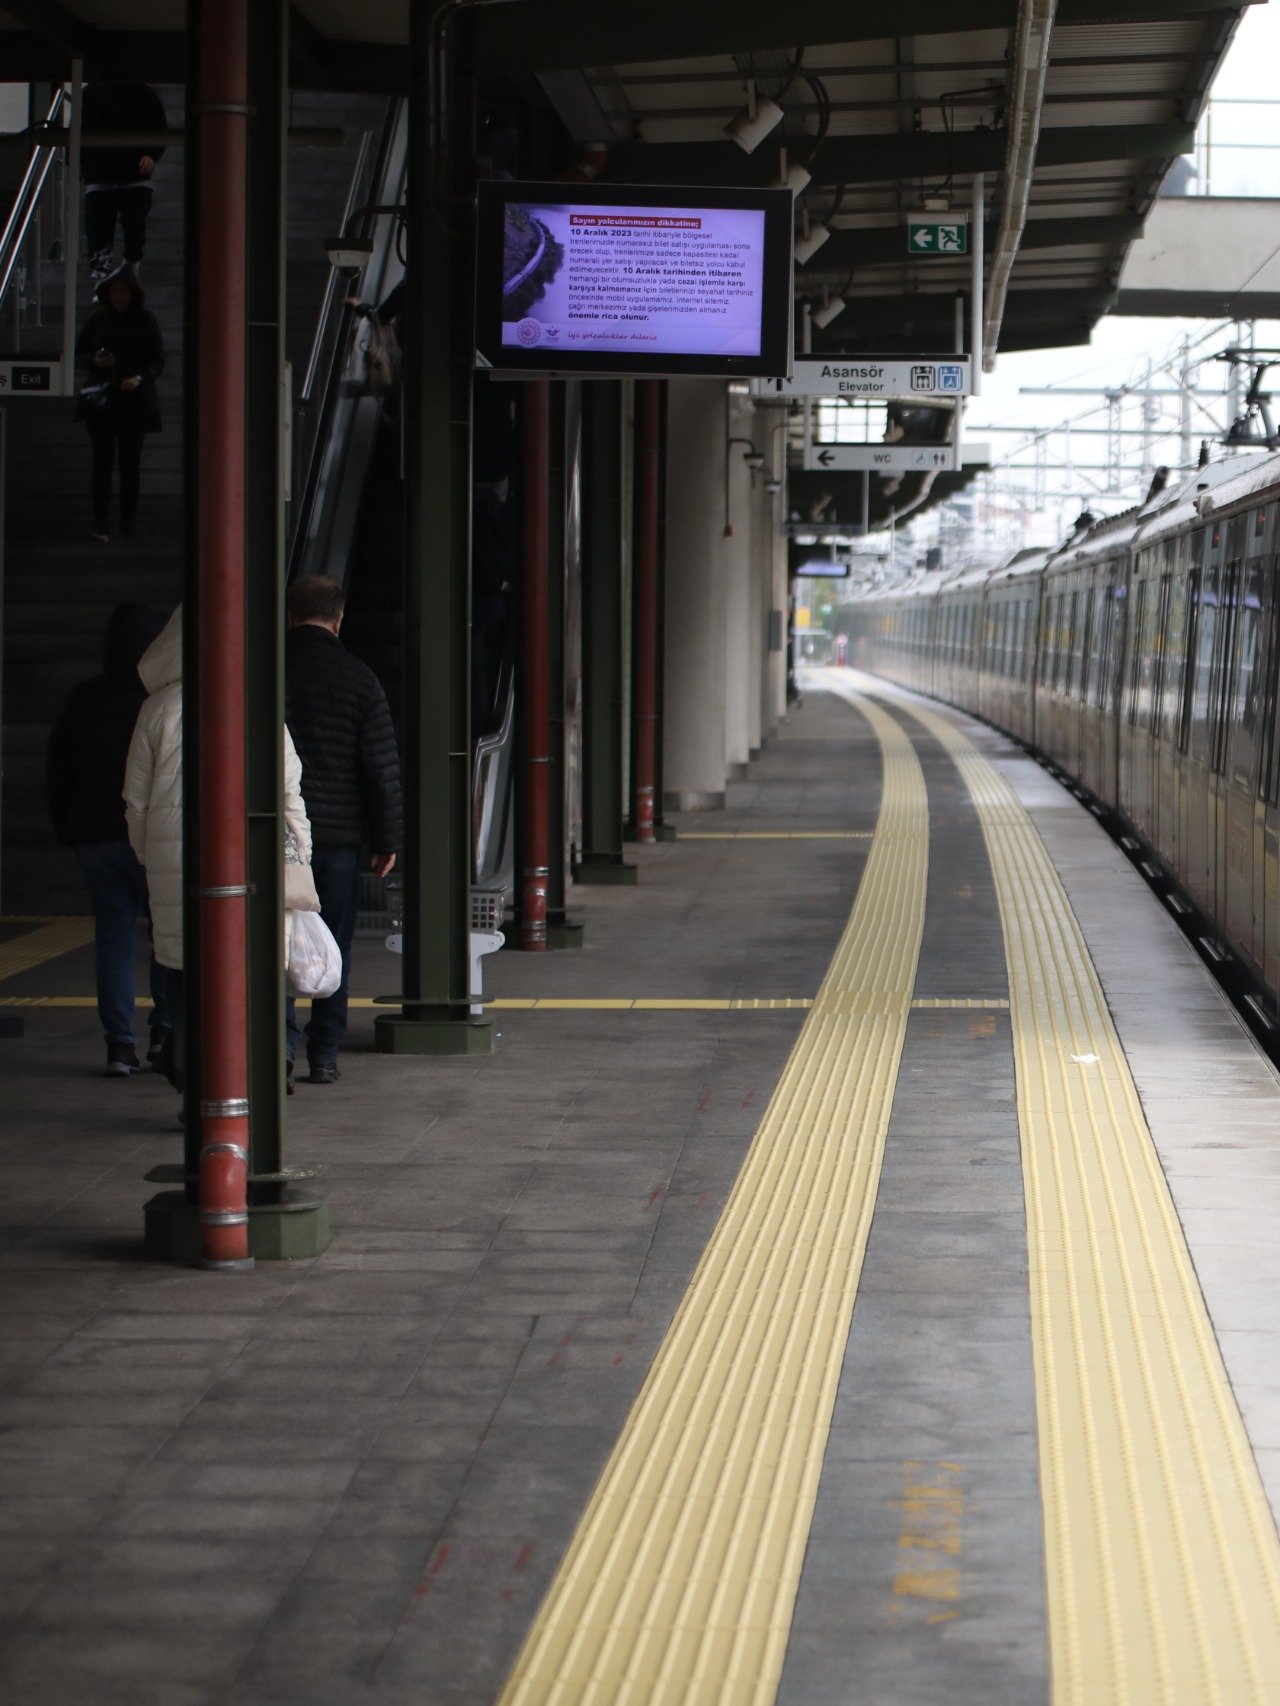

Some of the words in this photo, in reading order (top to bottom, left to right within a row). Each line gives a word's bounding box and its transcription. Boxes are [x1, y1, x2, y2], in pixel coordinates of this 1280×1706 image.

[572, 217, 596, 225] Sayın
[598, 218, 655, 227] yolcularımızın
[658, 220, 699, 228] dikkatine;
[708, 269, 742, 277] itibaren
[569, 303, 586, 311] çağrı
[822, 365, 884, 377] Asansör
[21, 374, 41, 383] Exit
[839, 382, 884, 391] Elevator
[874, 454, 892, 463] WC
